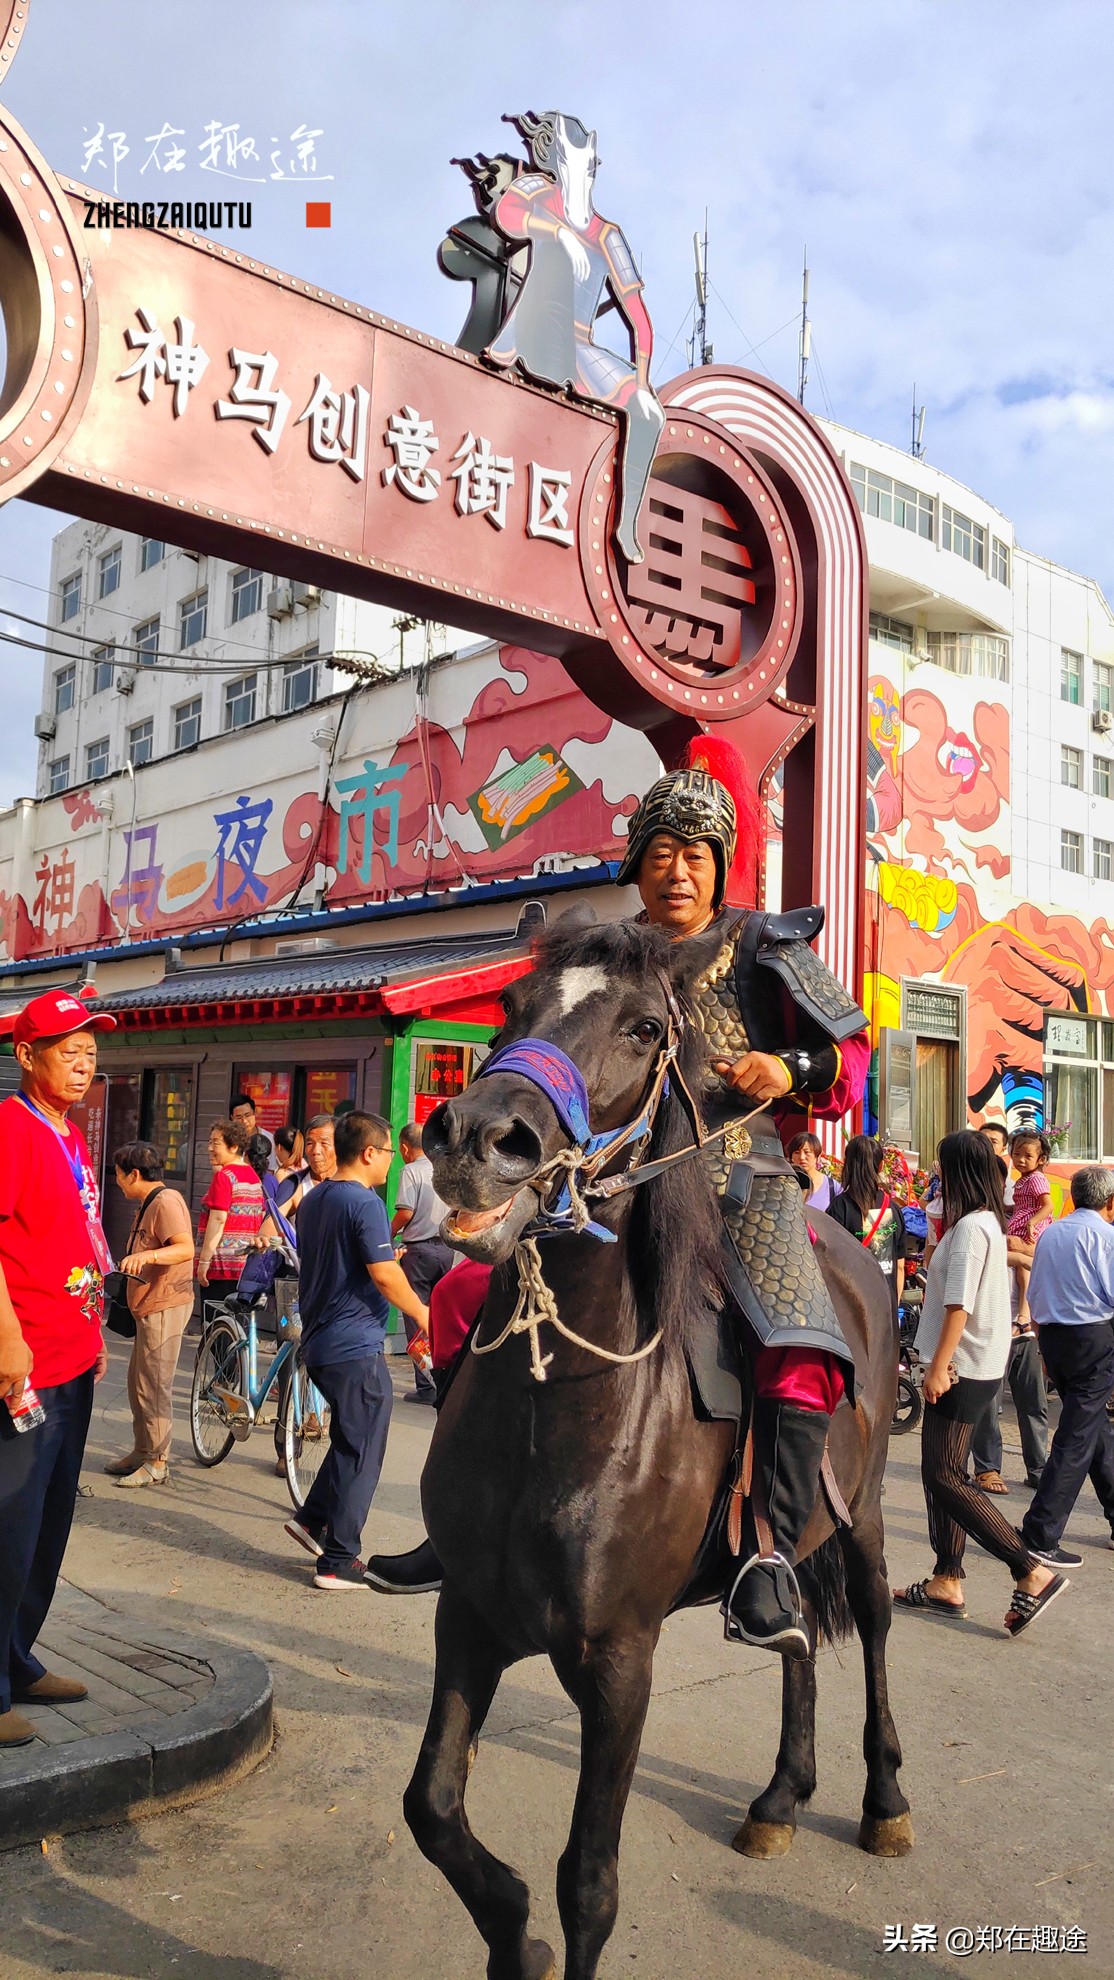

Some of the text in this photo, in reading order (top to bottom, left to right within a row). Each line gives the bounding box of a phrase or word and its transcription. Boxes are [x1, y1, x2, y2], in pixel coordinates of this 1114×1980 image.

[117, 307, 575, 547] 神马创意街区
[33, 760, 409, 948] 神马夜市
